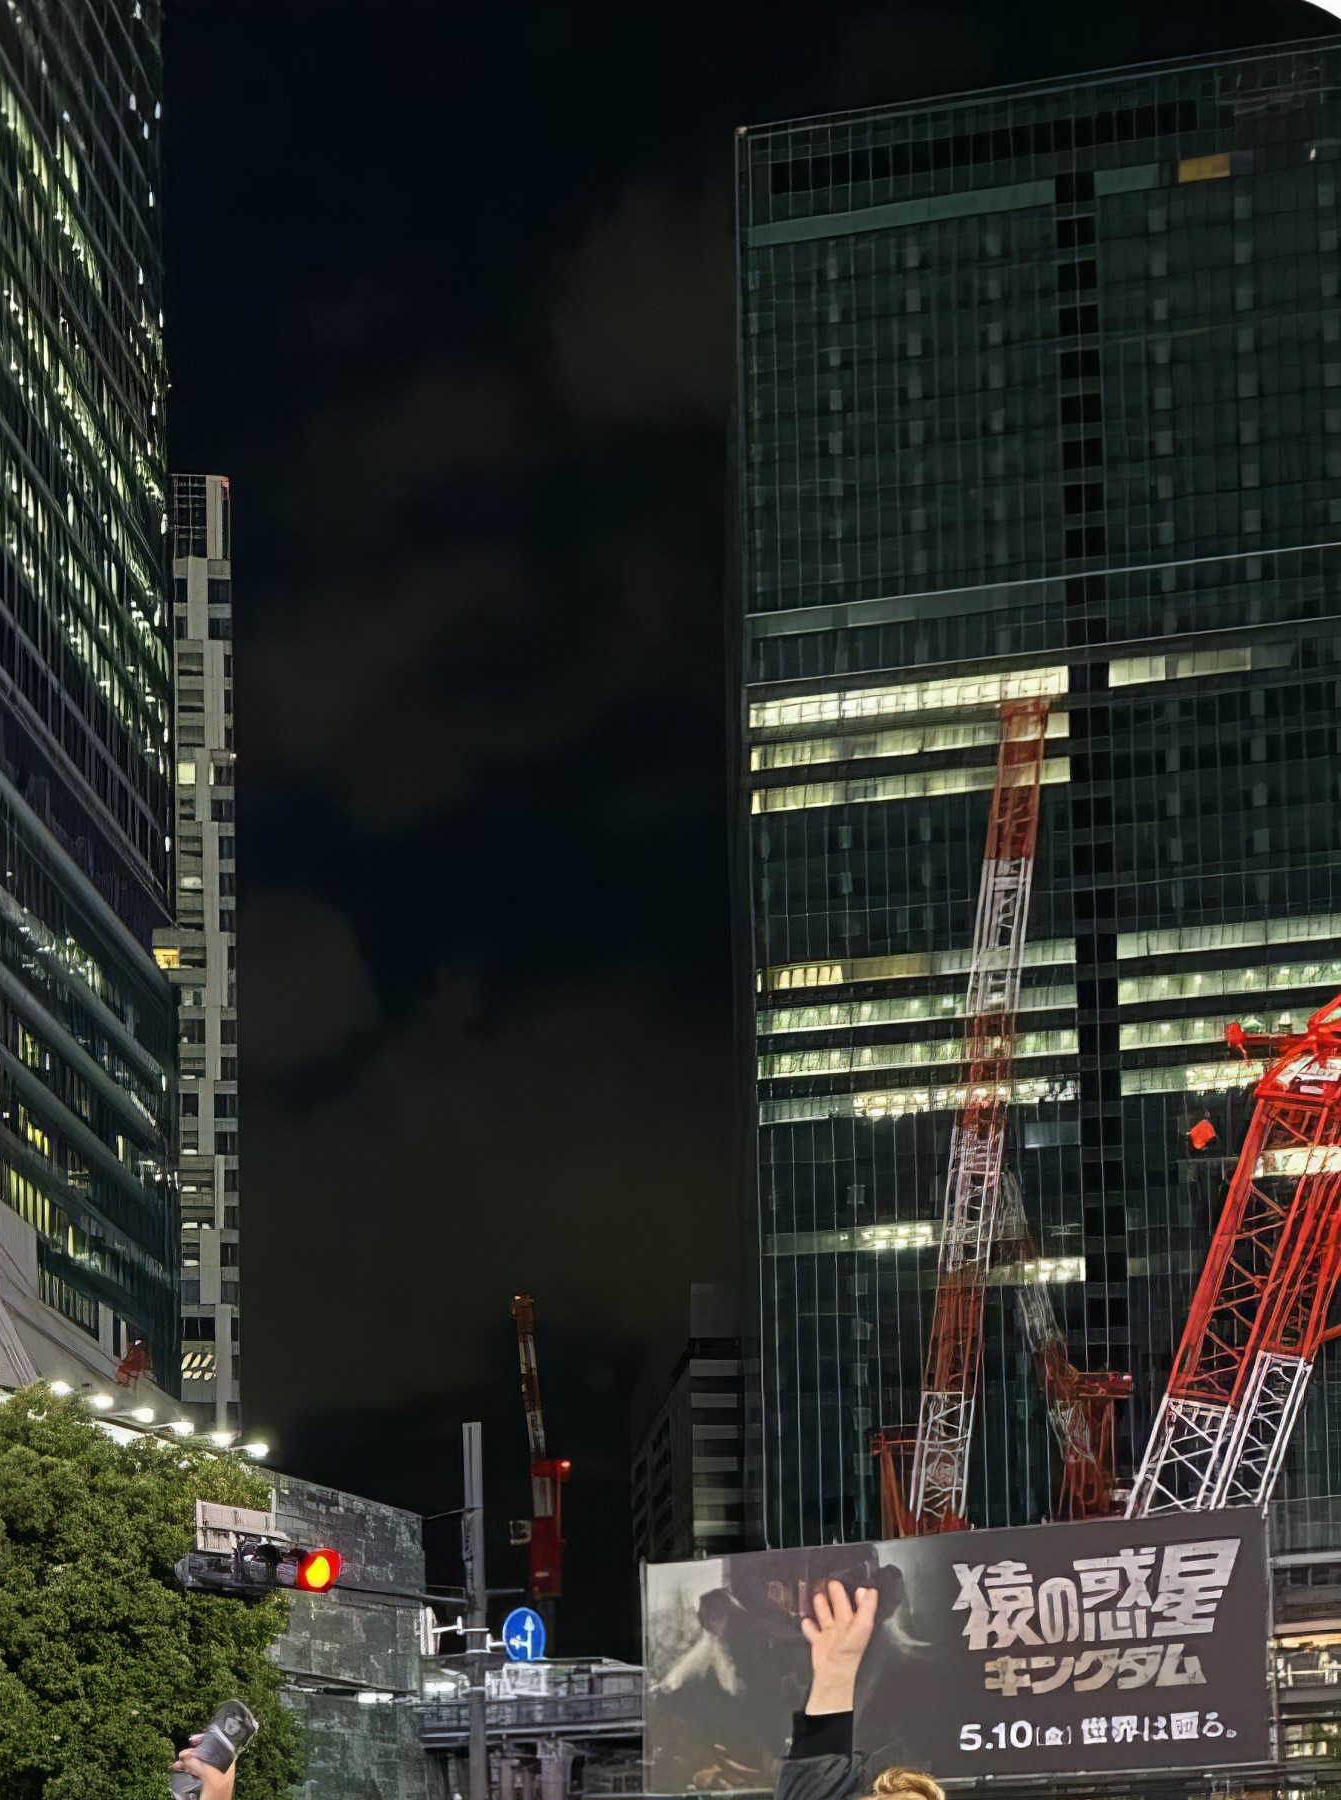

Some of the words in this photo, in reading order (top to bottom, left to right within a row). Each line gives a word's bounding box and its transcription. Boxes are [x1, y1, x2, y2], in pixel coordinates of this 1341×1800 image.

[952, 1538, 1241, 1650] 猿の惑星
[984, 1643, 1207, 1696] キングダム
